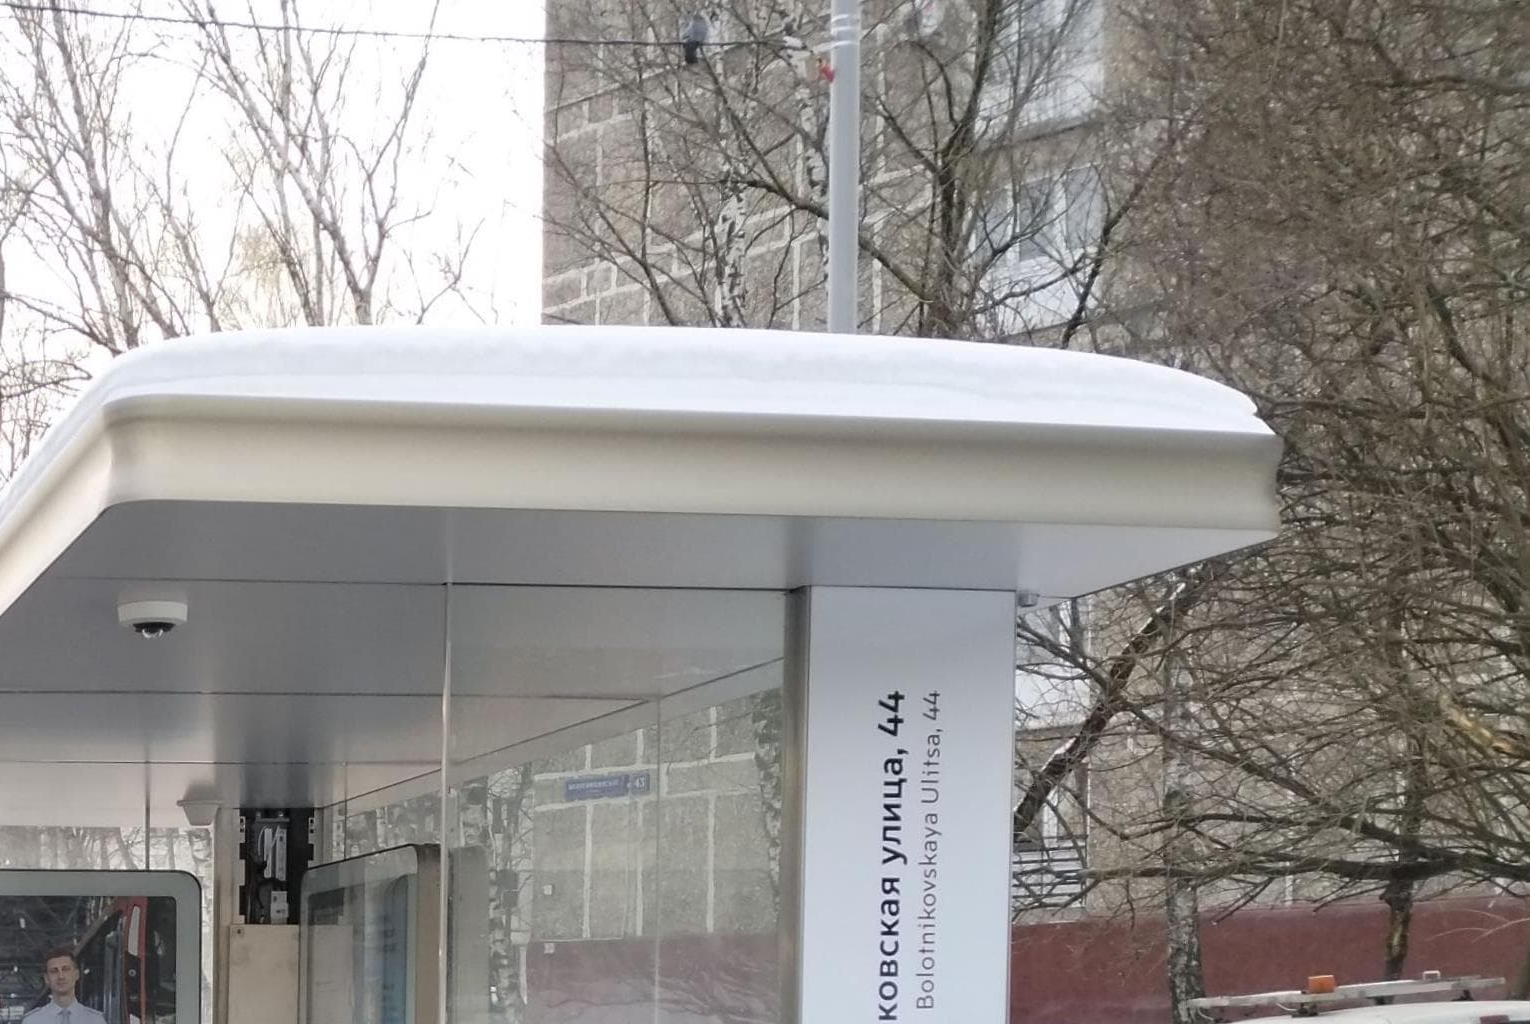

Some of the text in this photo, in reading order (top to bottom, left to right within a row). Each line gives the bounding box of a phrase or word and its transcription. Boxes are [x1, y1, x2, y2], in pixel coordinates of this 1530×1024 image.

[878, 690, 906, 737] 44
[880, 748, 910, 865] улица,
[916, 690, 944, 1010] Bolotnikovskaya Ulitsa, 44
